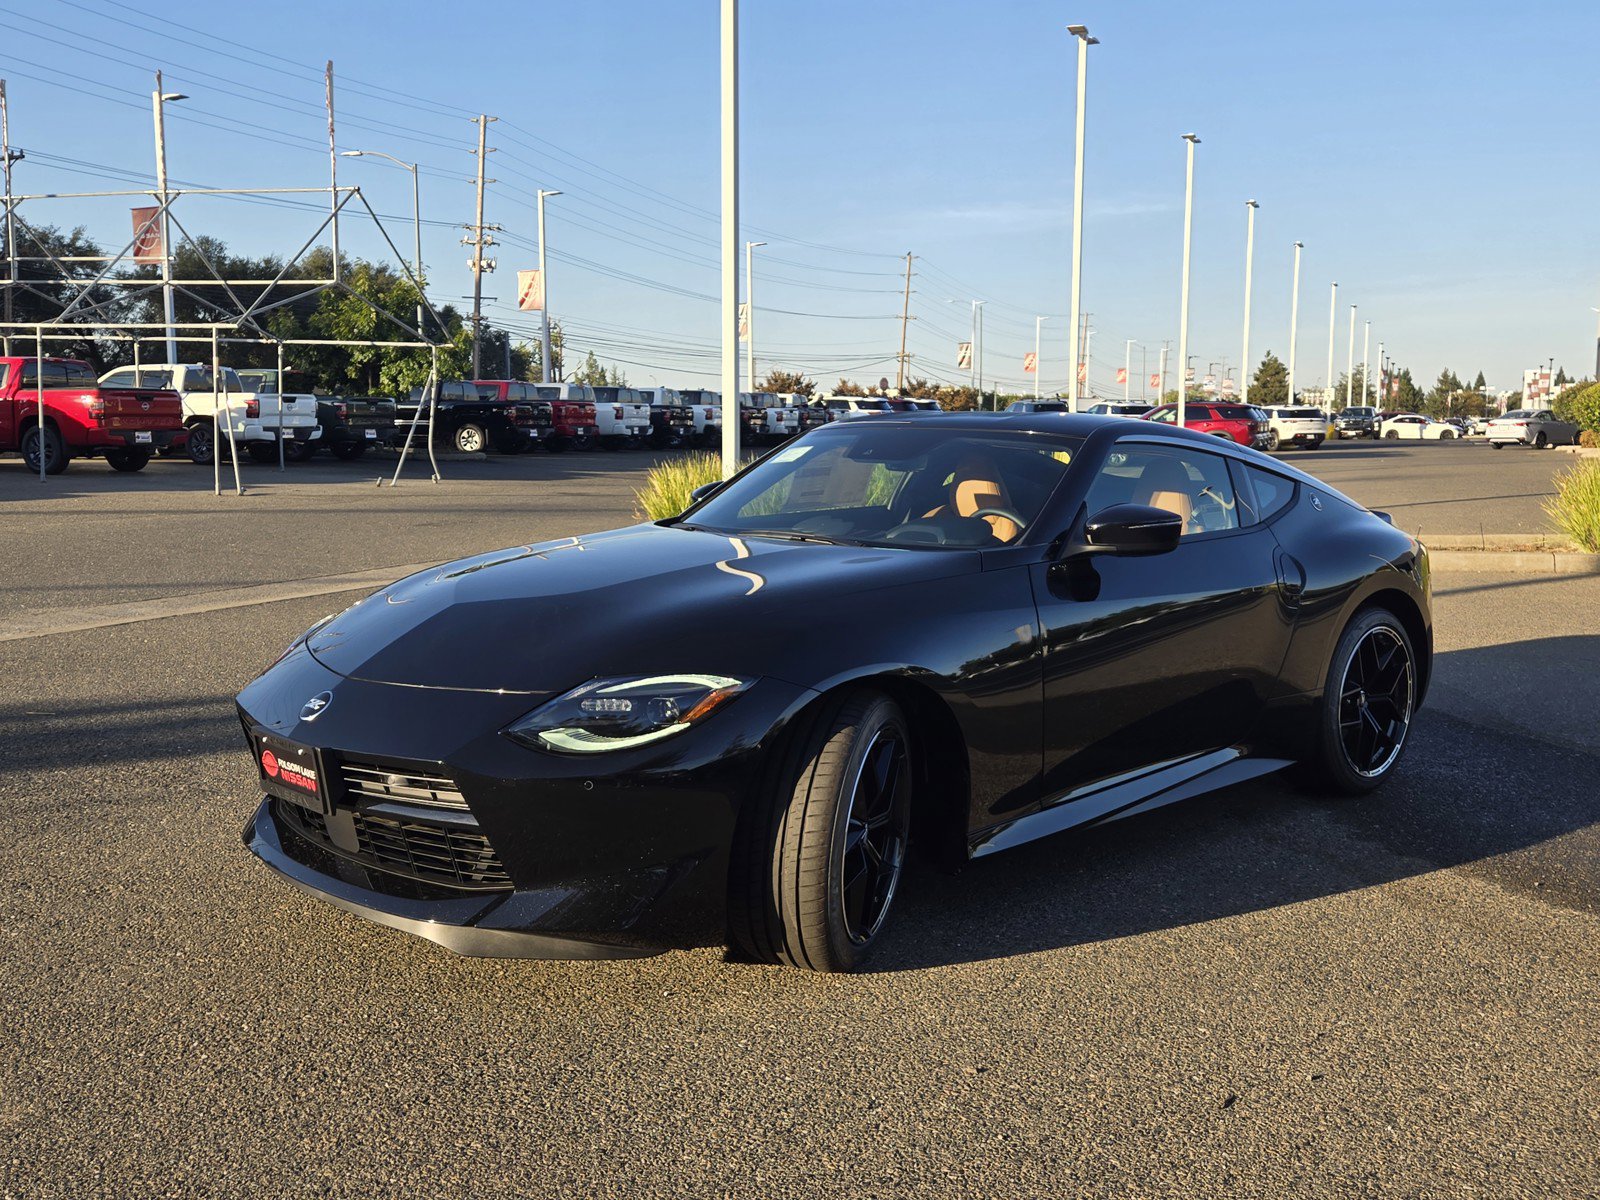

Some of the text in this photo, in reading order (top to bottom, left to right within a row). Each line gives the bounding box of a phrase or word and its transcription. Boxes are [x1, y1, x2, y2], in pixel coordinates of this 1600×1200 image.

[277, 758, 316, 780] FOLSOM LAKE
[280, 769, 317, 792] NISSAN
